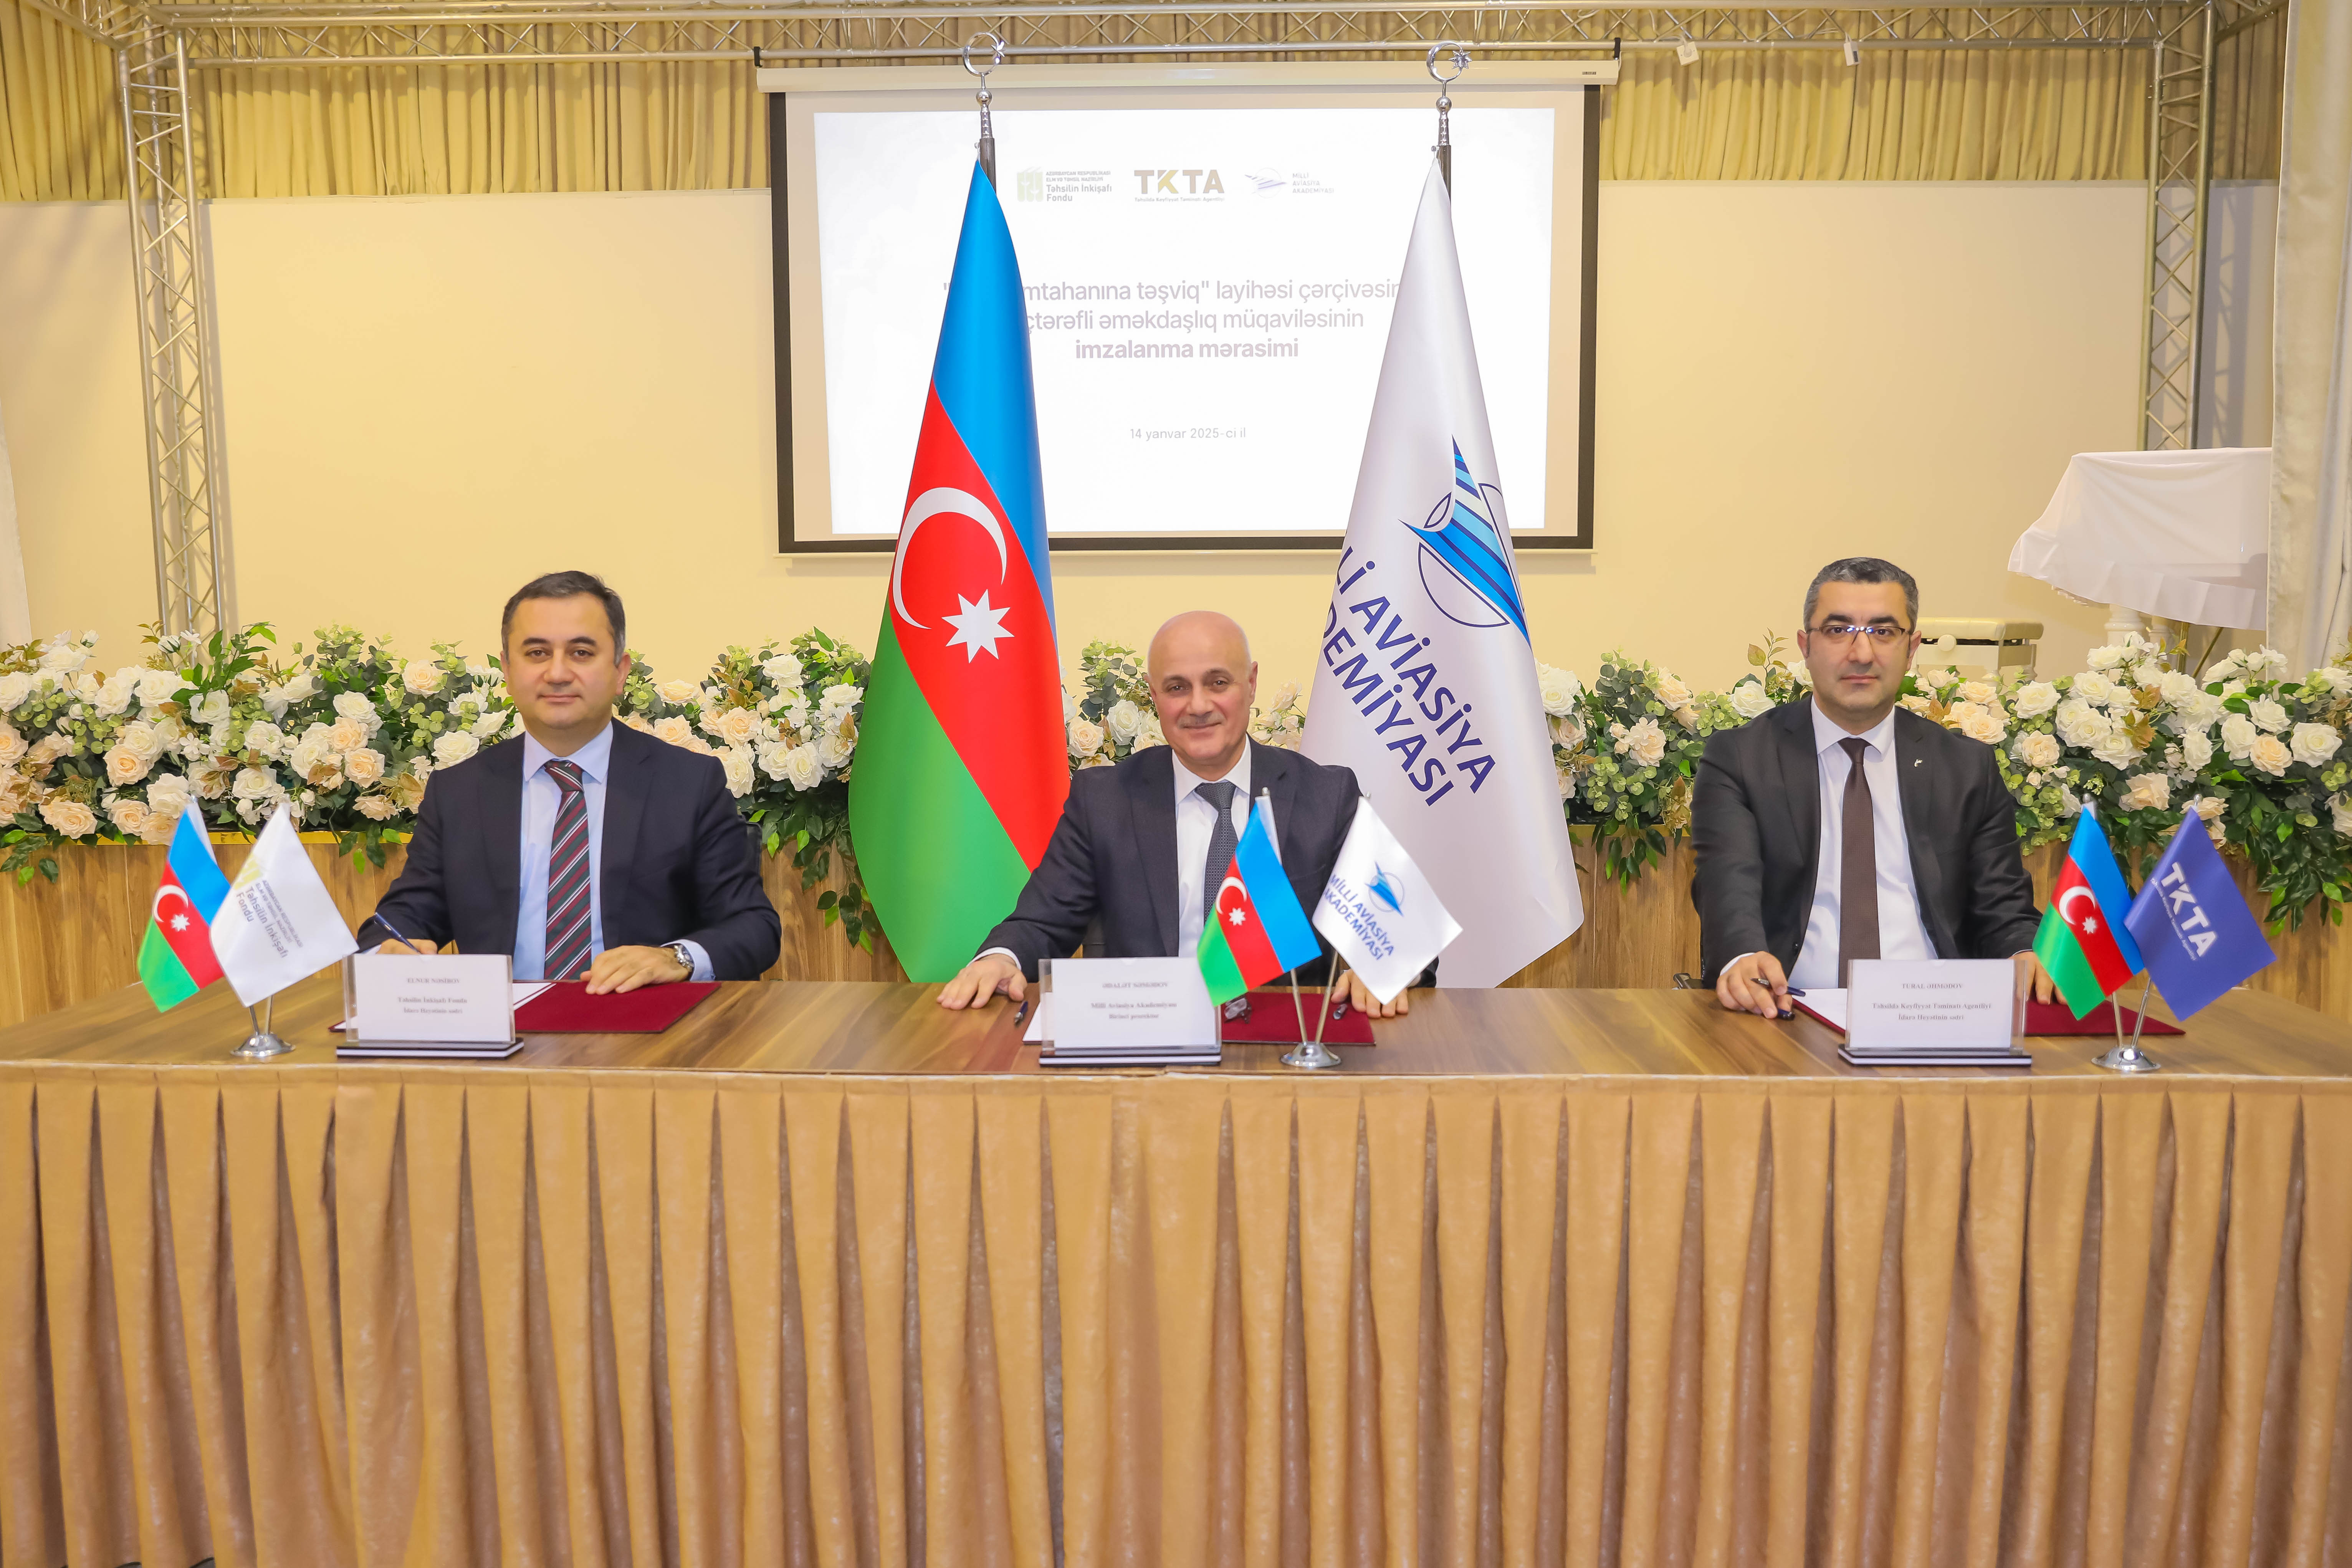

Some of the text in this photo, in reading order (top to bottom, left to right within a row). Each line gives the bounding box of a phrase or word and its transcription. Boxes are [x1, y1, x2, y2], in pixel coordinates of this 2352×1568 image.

[1046, 183, 1112, 194] Təhsilin İnkişafı
[1134, 169, 1225, 194] TKTA
[1047, 194, 1073, 202] Fondu
[1023, 282, 1131, 301] mtahanına
[1217, 280, 1292, 304] layihəsi
[1027, 308, 1363, 334] çtərəfli əməkdaşlıq müqaviləsinin
[1076, 338, 1298, 359] imzalanma mərasimi
[1130, 427, 1245, 442] 14 yanvar 2025-ci il
[1323, 600, 1454, 806] DEMİYASI
[1349, 596, 1496, 794] AVİASİYA
[237, 892, 255, 922] Fondu
[2161, 862, 2217, 957] TKTA
